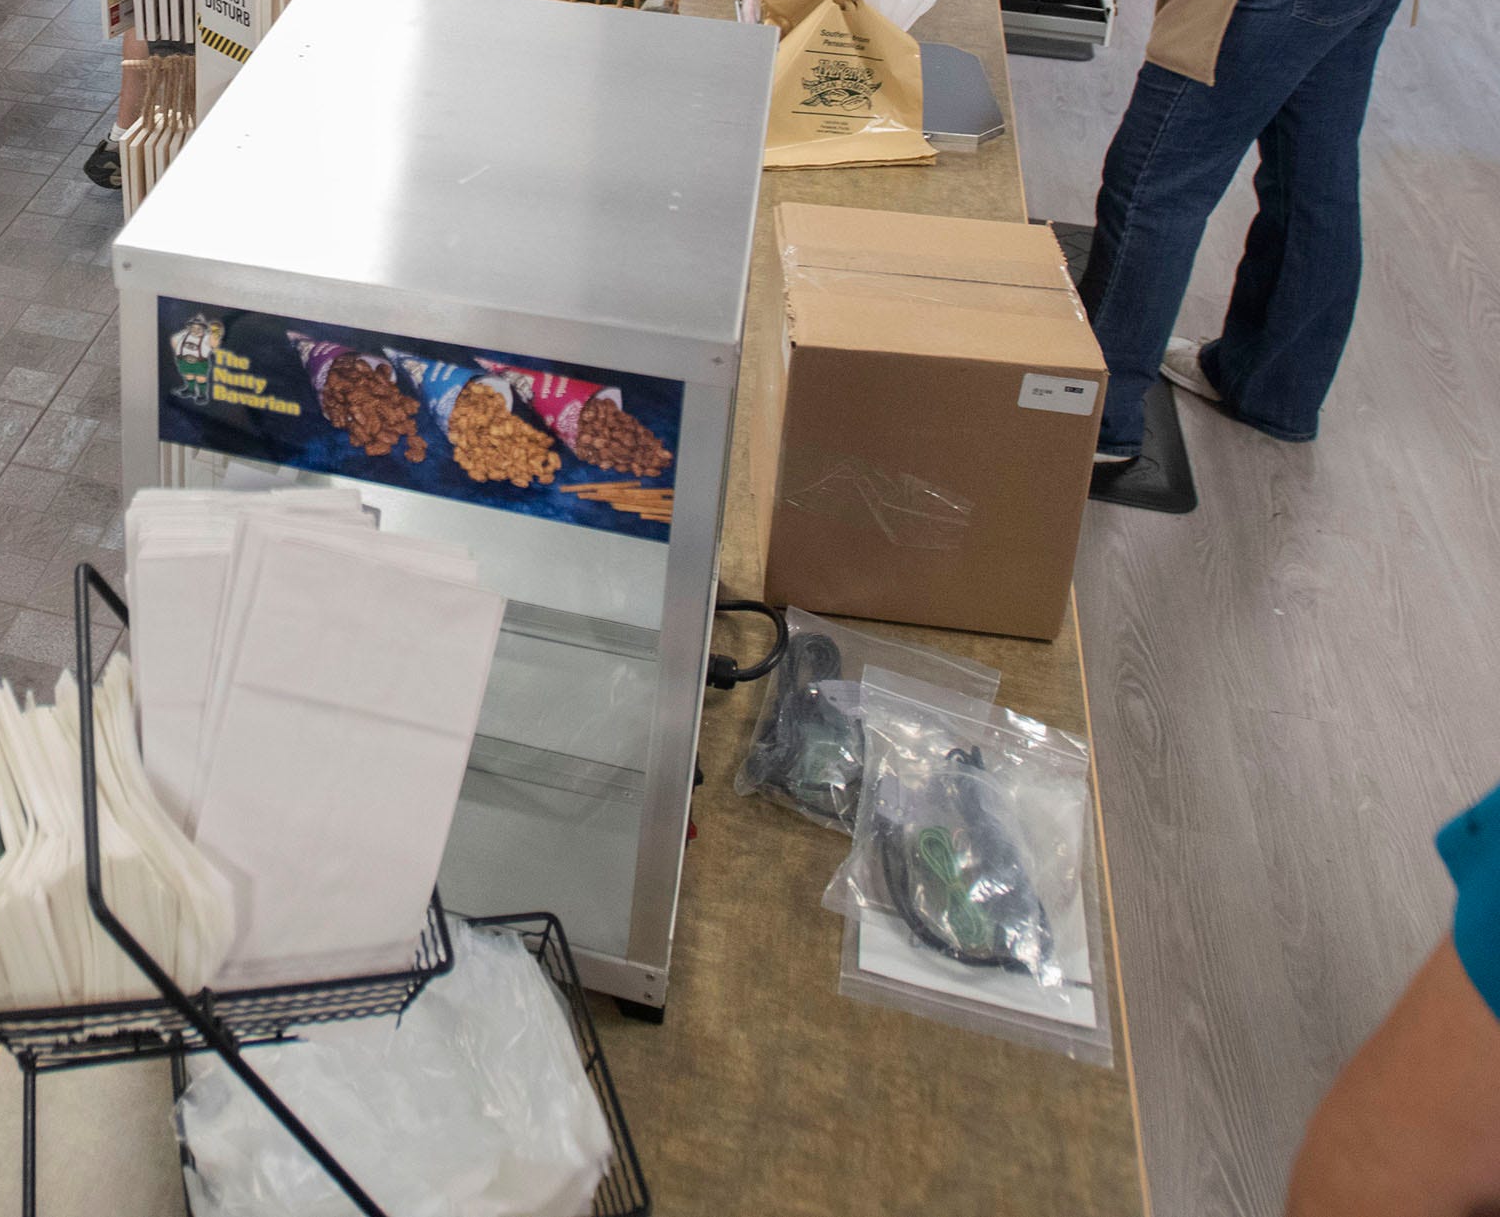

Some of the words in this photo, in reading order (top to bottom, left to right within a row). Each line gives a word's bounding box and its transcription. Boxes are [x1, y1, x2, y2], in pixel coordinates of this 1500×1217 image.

[214, 348, 251, 370] The
[213, 367, 267, 394] Nutty
[213, 384, 301, 416] Bavarian
